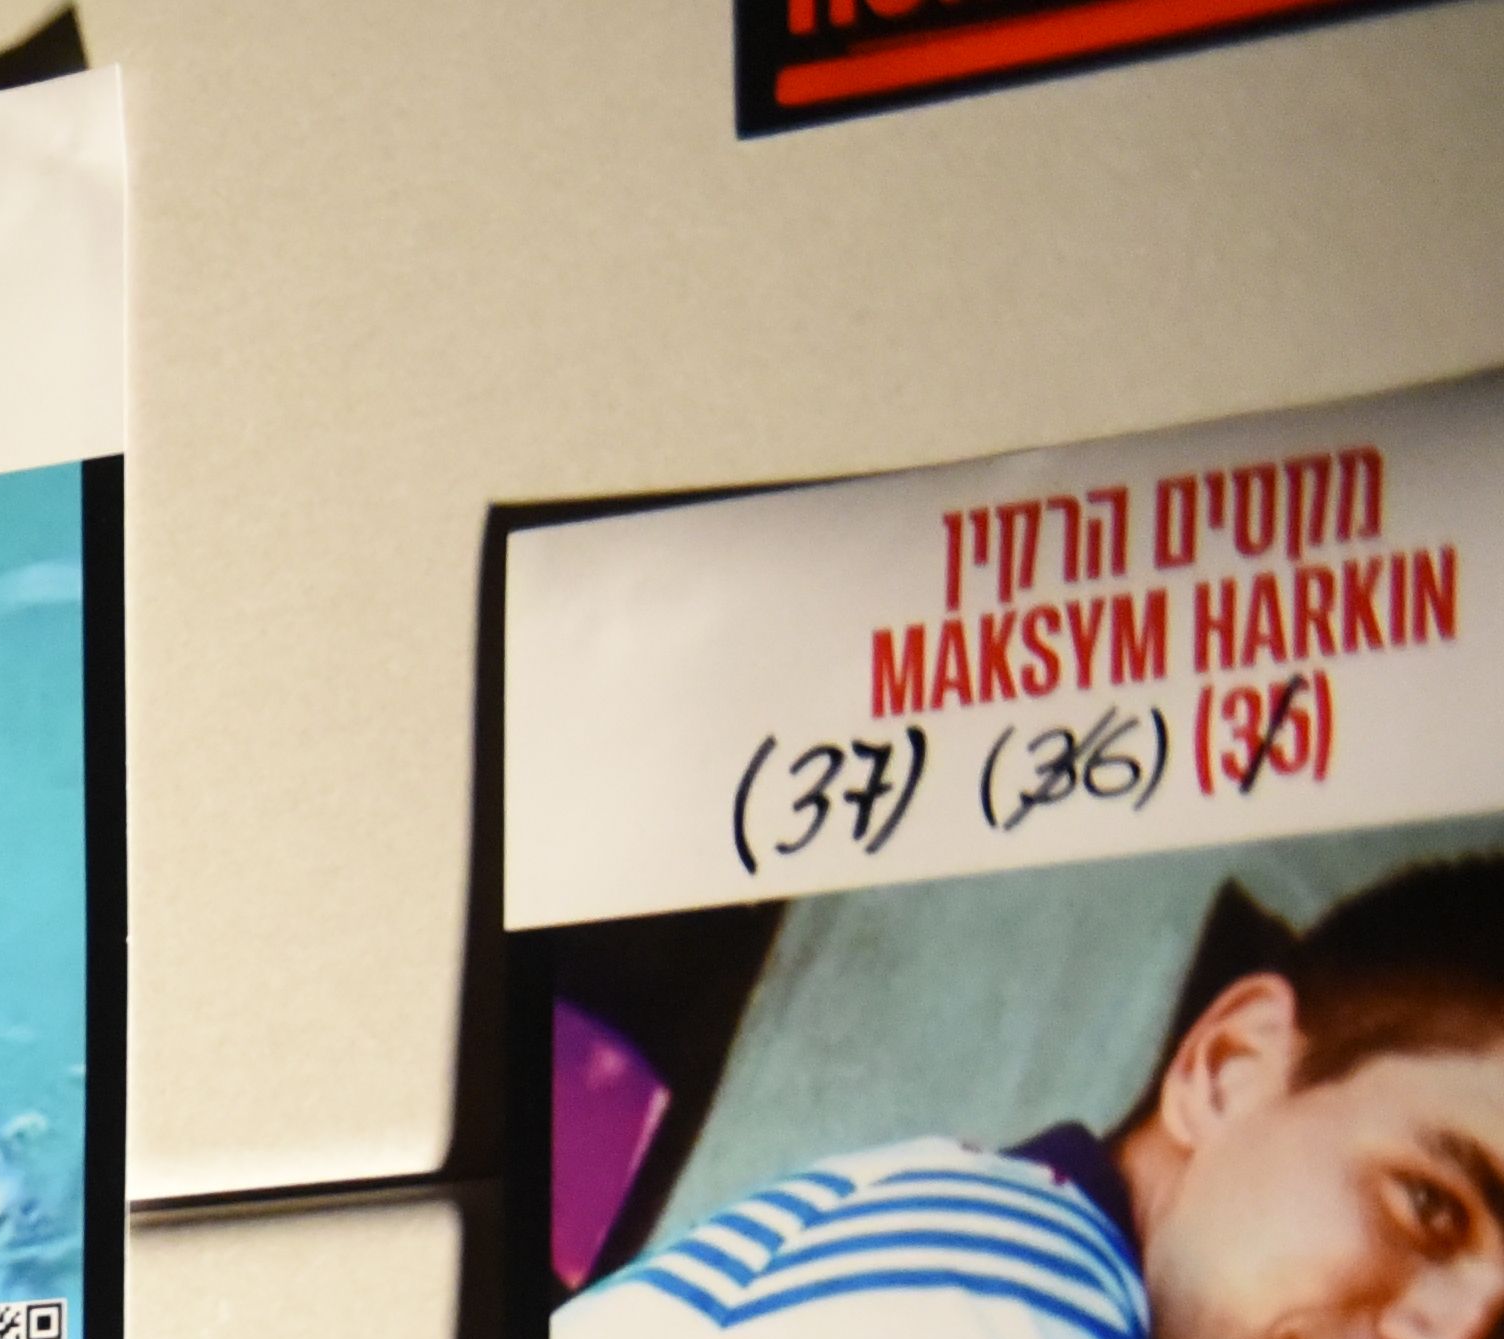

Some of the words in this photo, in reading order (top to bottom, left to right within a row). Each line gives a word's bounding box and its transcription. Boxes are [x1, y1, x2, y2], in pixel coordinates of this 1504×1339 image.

[942, 486, 1130, 611] הרקין
[1154, 444, 1384, 571] מקסים
[870, 588, 1168, 719] MAKSYM
[1192, 545, 1459, 674] HARKIN
[731, 725, 928, 876] (37)
